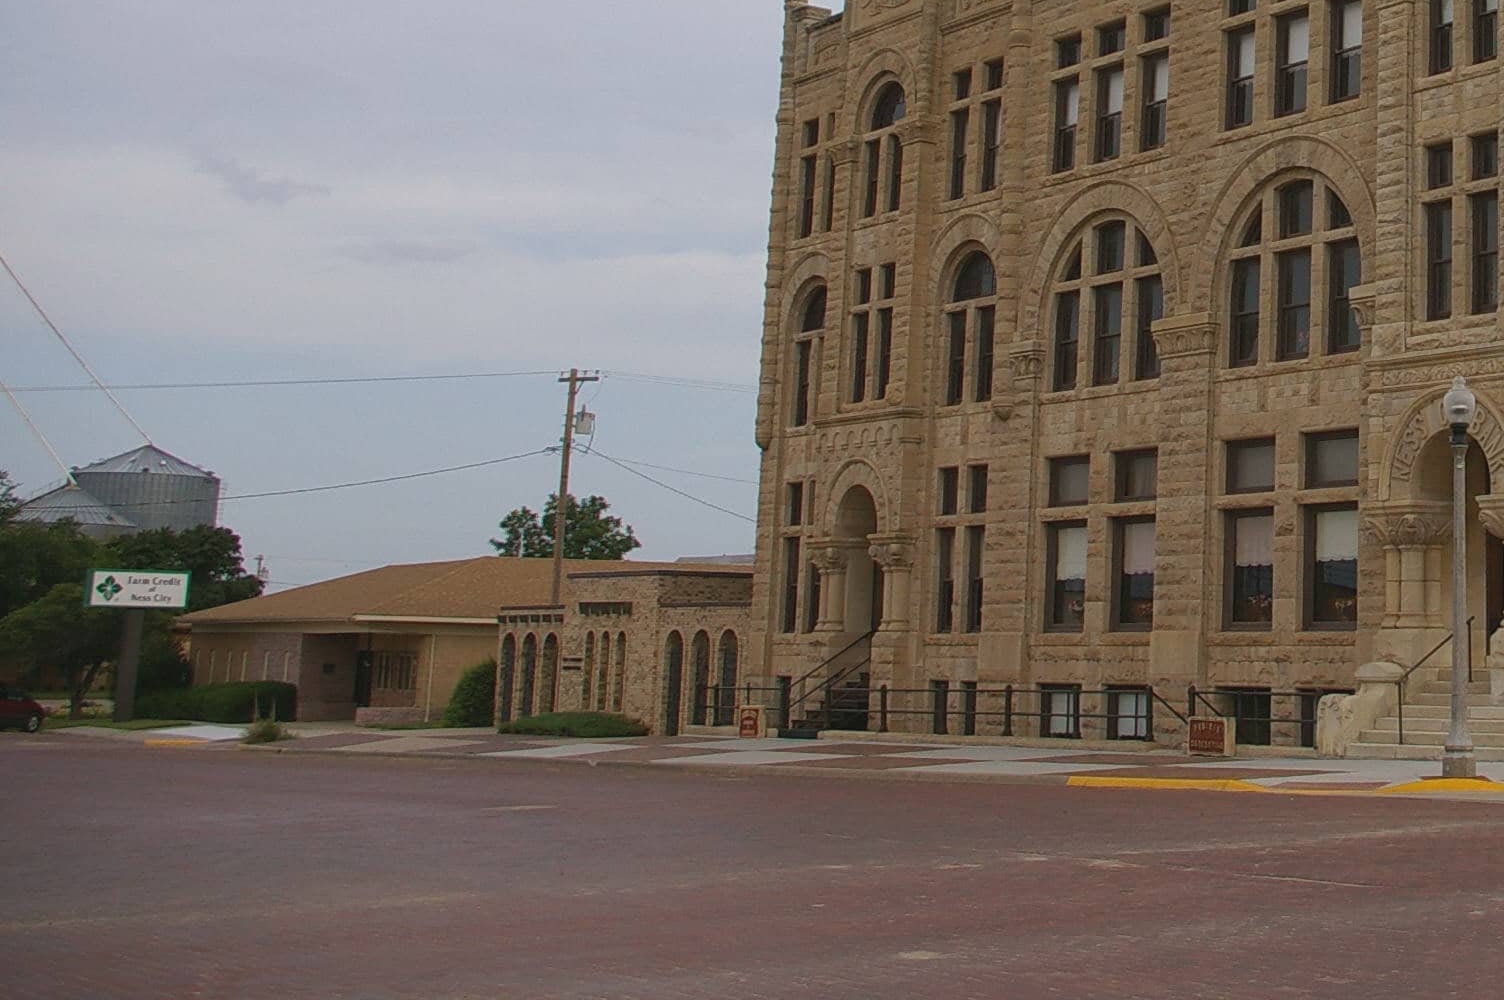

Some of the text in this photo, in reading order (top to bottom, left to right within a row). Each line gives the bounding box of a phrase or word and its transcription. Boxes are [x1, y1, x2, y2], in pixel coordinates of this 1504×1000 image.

[1391, 412, 1430, 482] NESS
[127, 575, 182, 586] Farm Credit
[130, 593, 172, 604] Ness City
